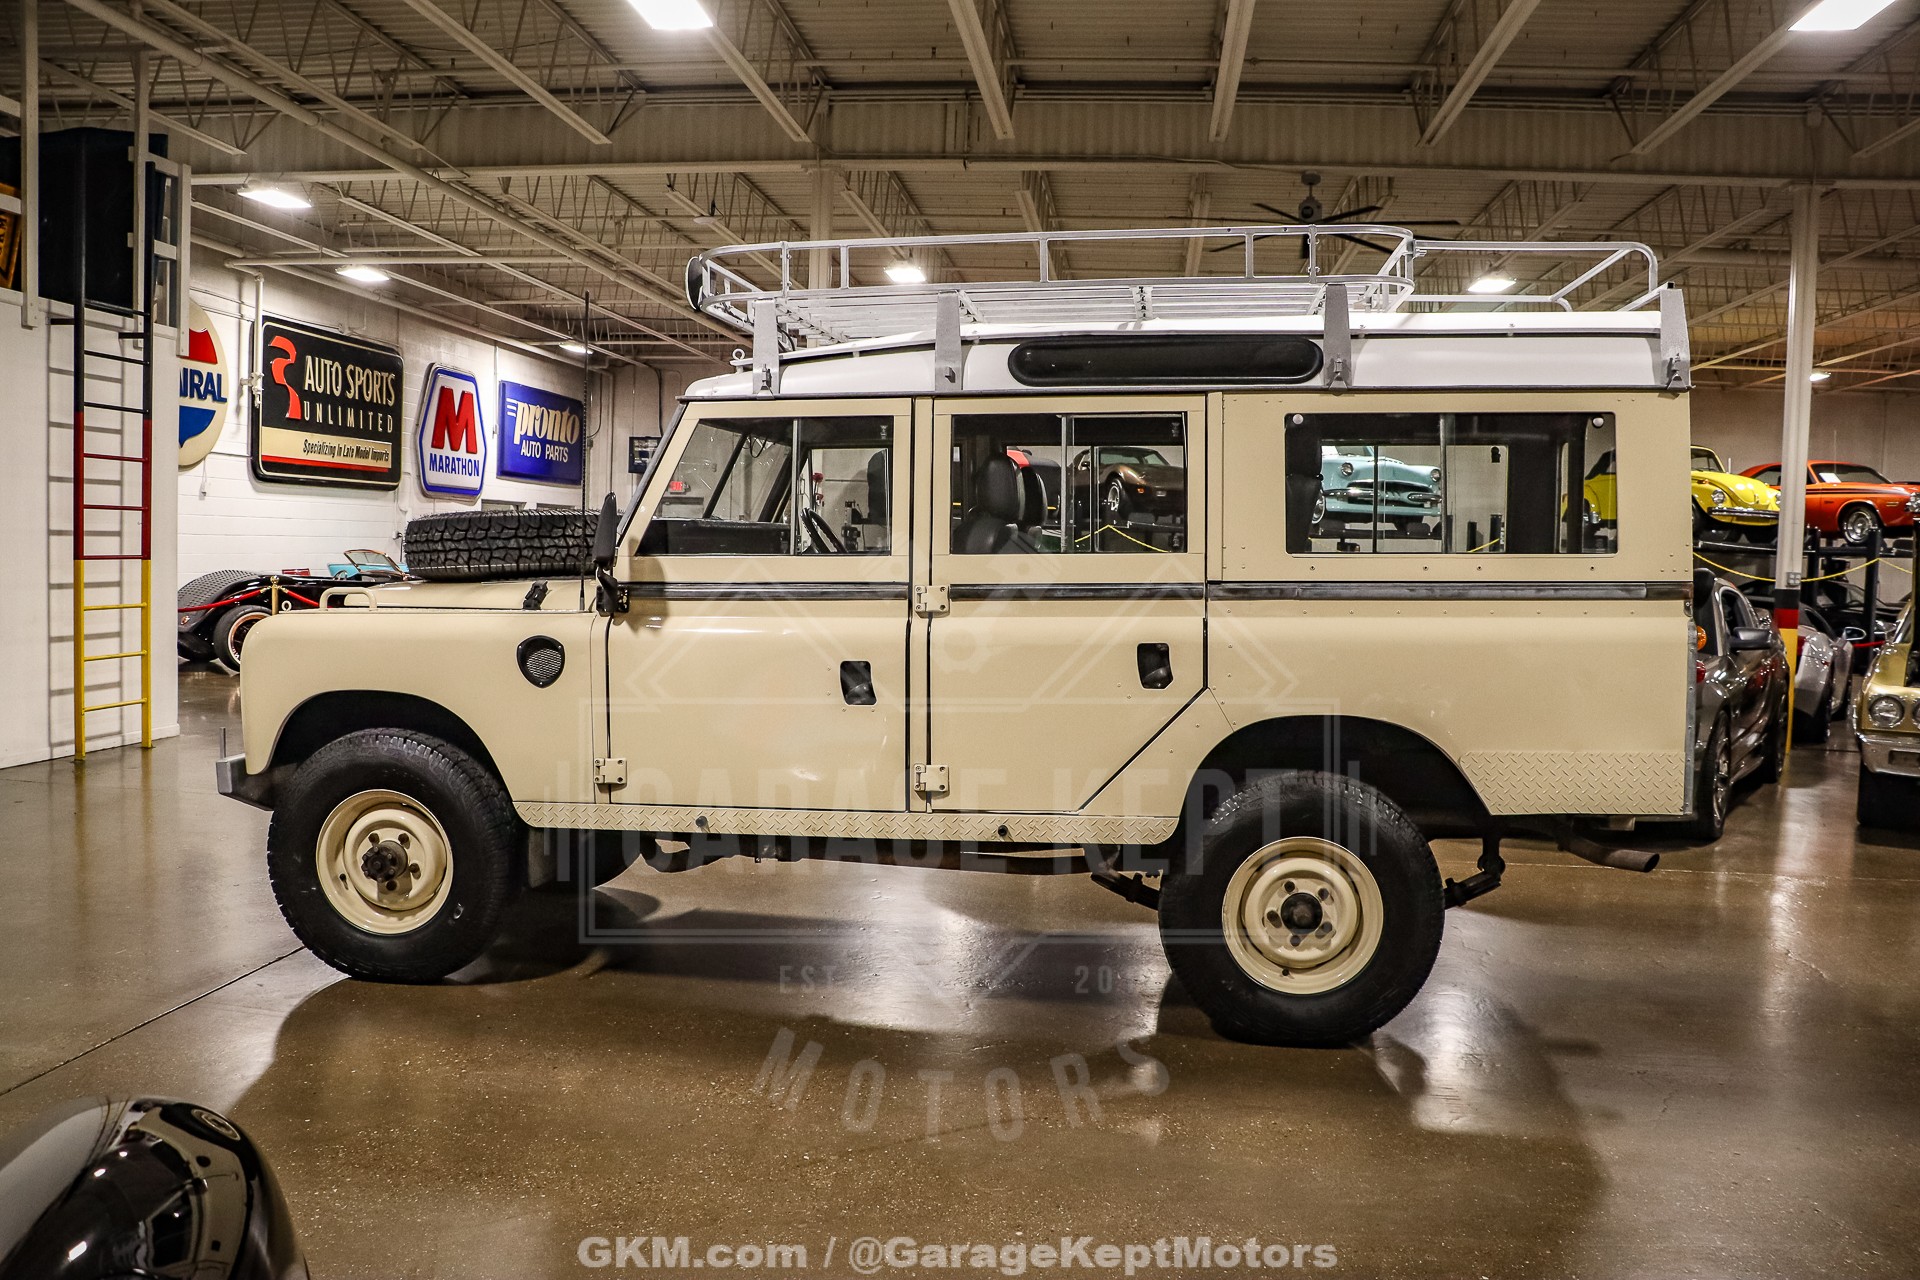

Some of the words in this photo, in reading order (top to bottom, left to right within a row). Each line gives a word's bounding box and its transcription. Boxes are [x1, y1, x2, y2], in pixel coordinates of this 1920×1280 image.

[180, 367, 227, 403] IRAL
[304, 355, 342, 397] AUTO
[345, 364, 396, 407] SPORTS
[303, 401, 394, 433] UNLIMITED
[431, 386, 477, 454] M
[511, 401, 580, 445] pronto
[303, 439, 336, 458] Specializing
[343, 445, 355, 458] Late
[355, 446, 371, 459] Model
[429, 453, 480, 477] MARATHON
[520, 440, 542, 459] AUTO
[545, 444, 569, 463] PARTS
